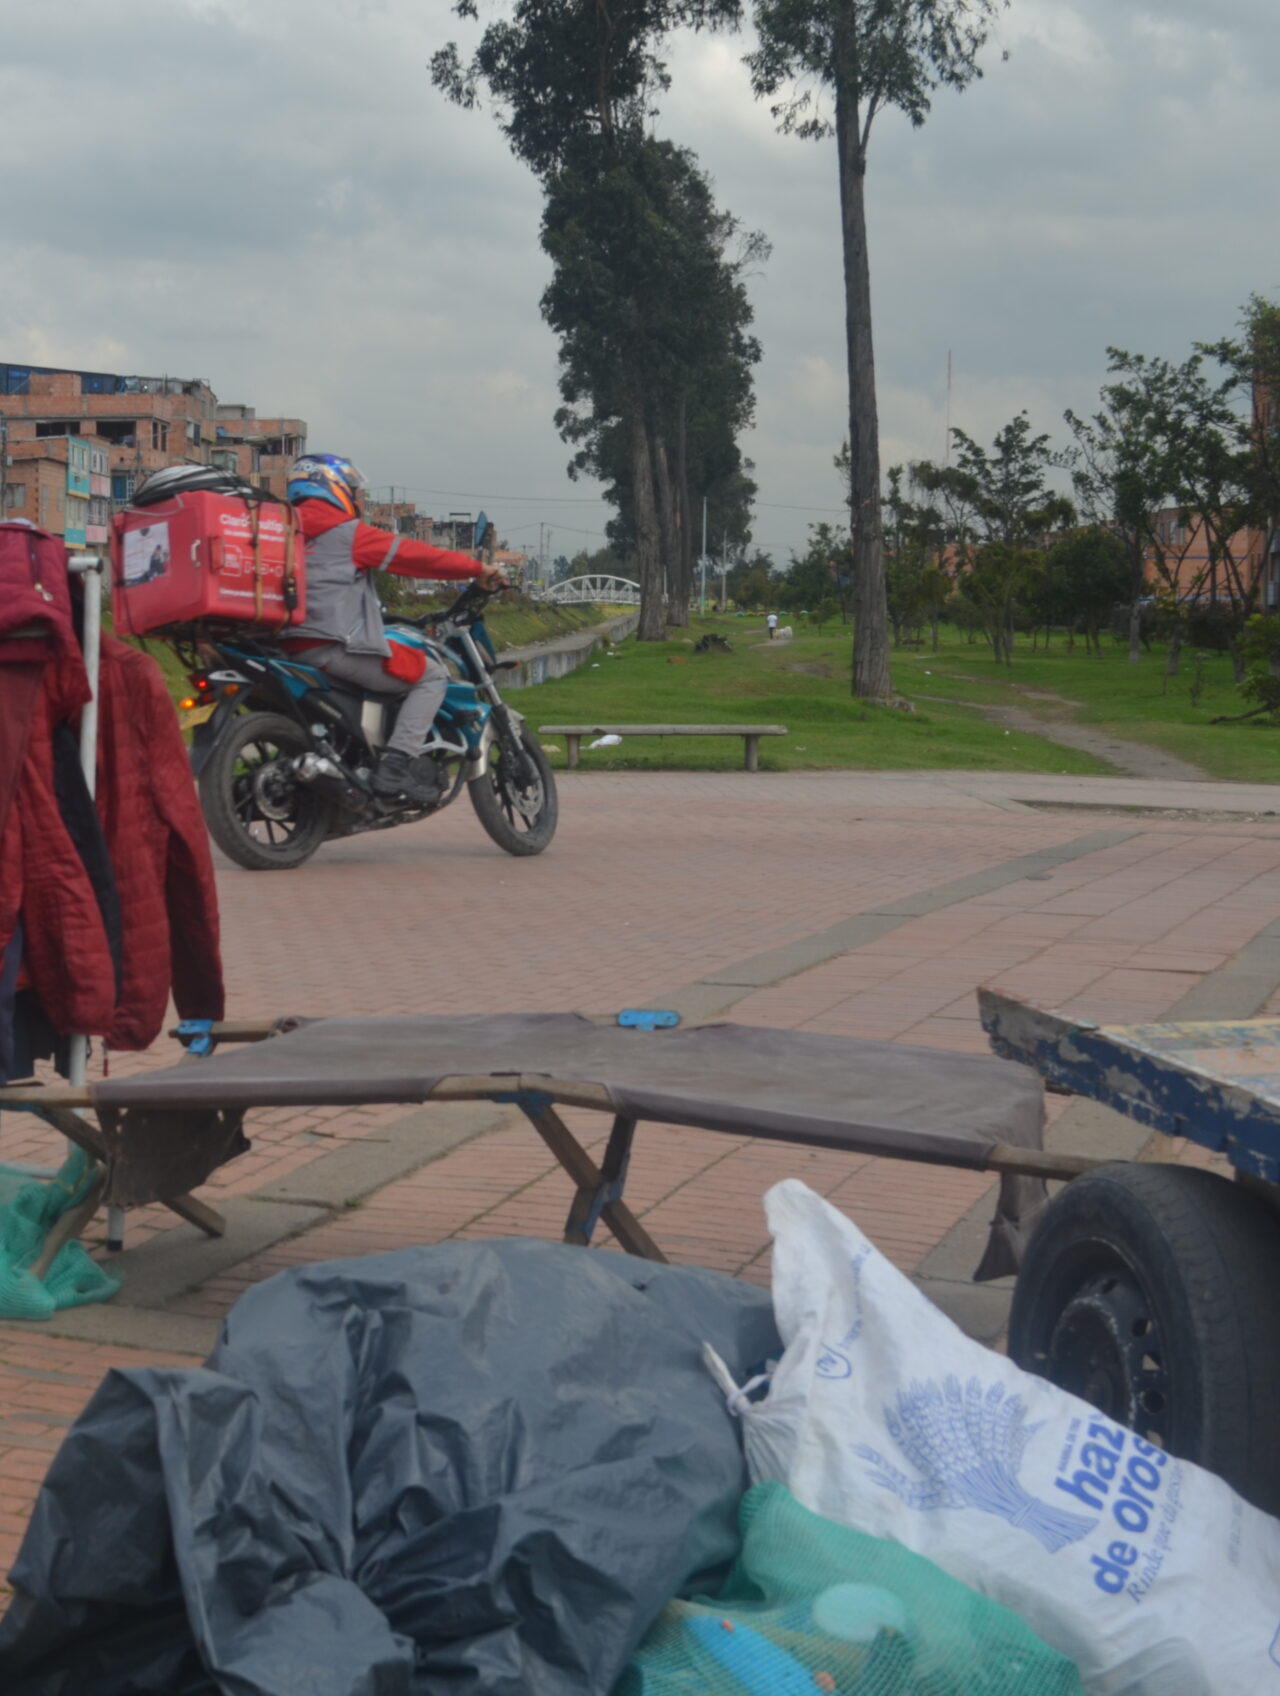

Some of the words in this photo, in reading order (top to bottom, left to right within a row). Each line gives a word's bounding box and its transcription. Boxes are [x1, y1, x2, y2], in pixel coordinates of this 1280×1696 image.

[1054, 1422, 1126, 1511] haz
[1112, 1436, 1168, 1533] oros
[1089, 1540, 1139, 1595] de
[1126, 1549, 1165, 1604] Rinde
